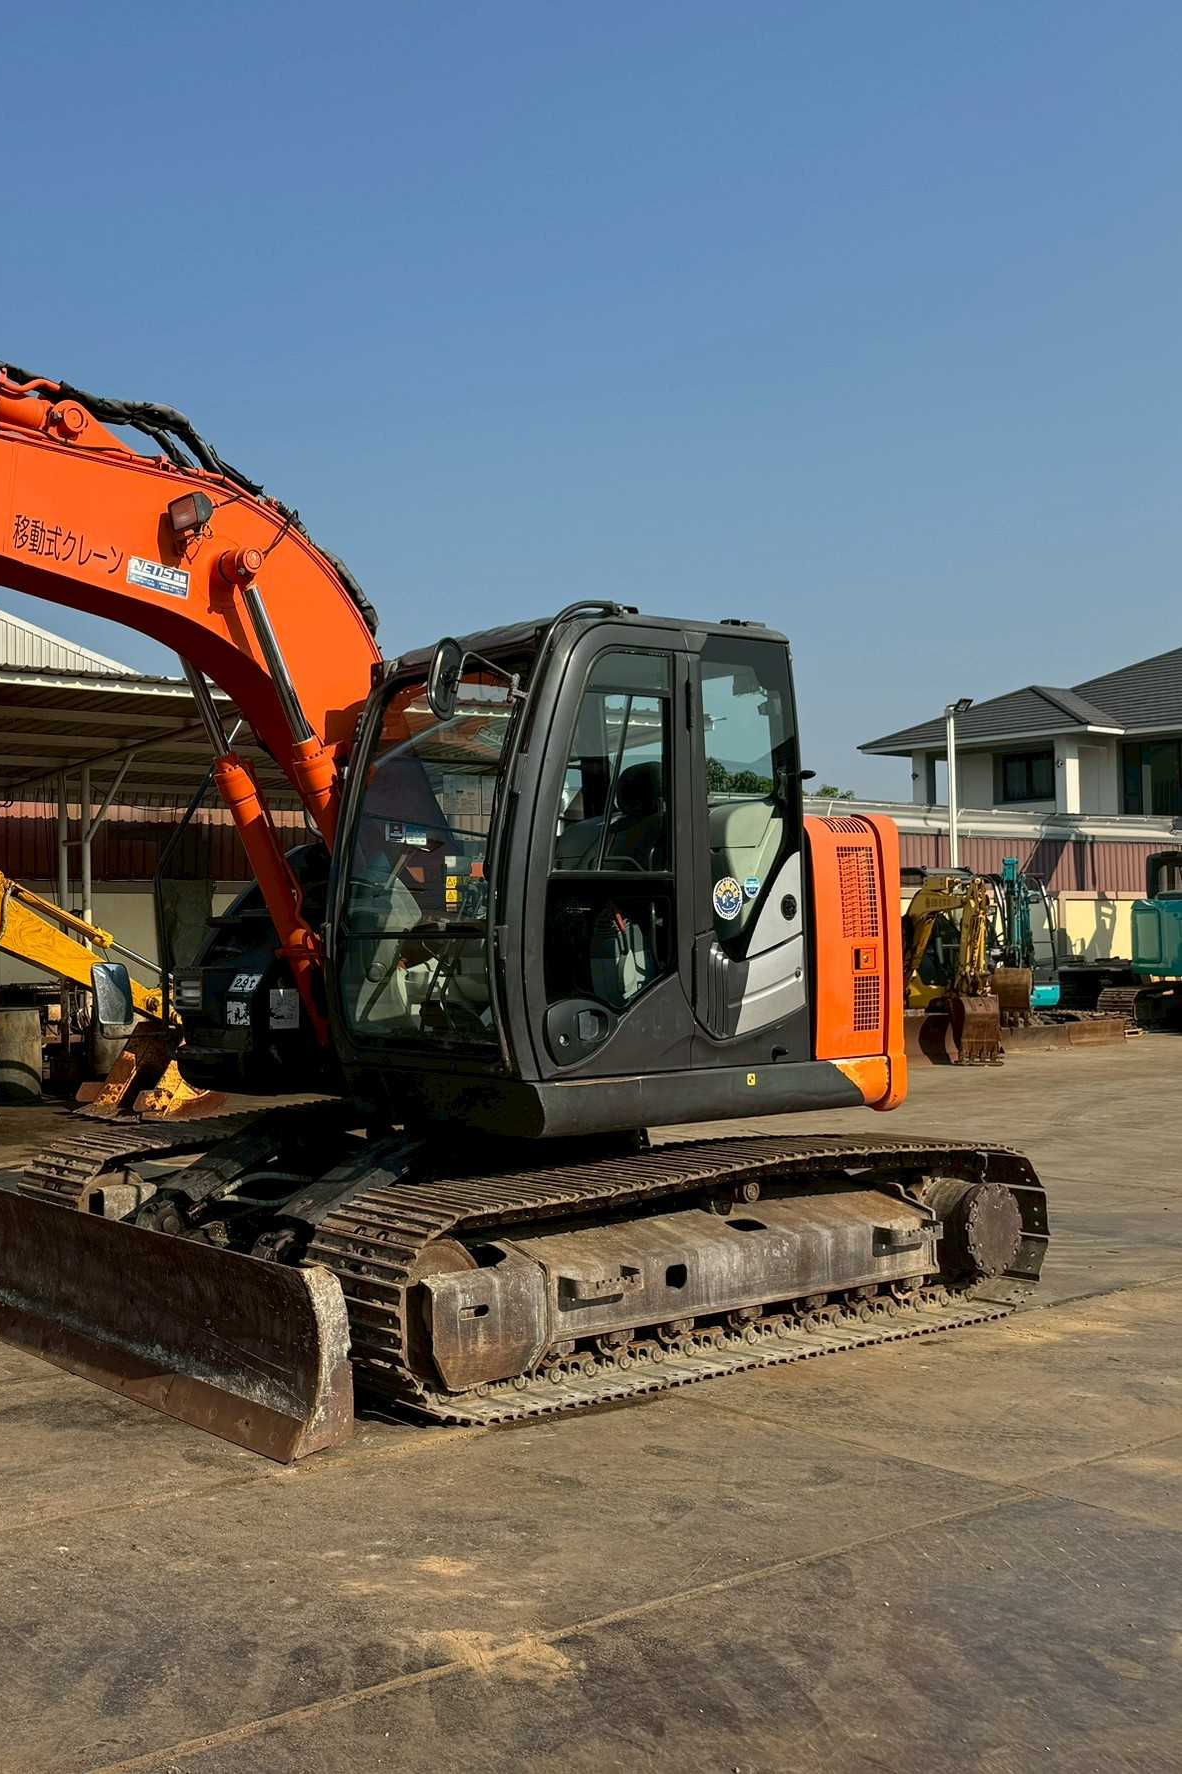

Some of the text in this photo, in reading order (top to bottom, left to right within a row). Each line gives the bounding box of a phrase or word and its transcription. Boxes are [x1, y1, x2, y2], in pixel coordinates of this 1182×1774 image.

[13, 514, 124, 574] 移動式クレーン
[130, 558, 174, 579] NETIS
